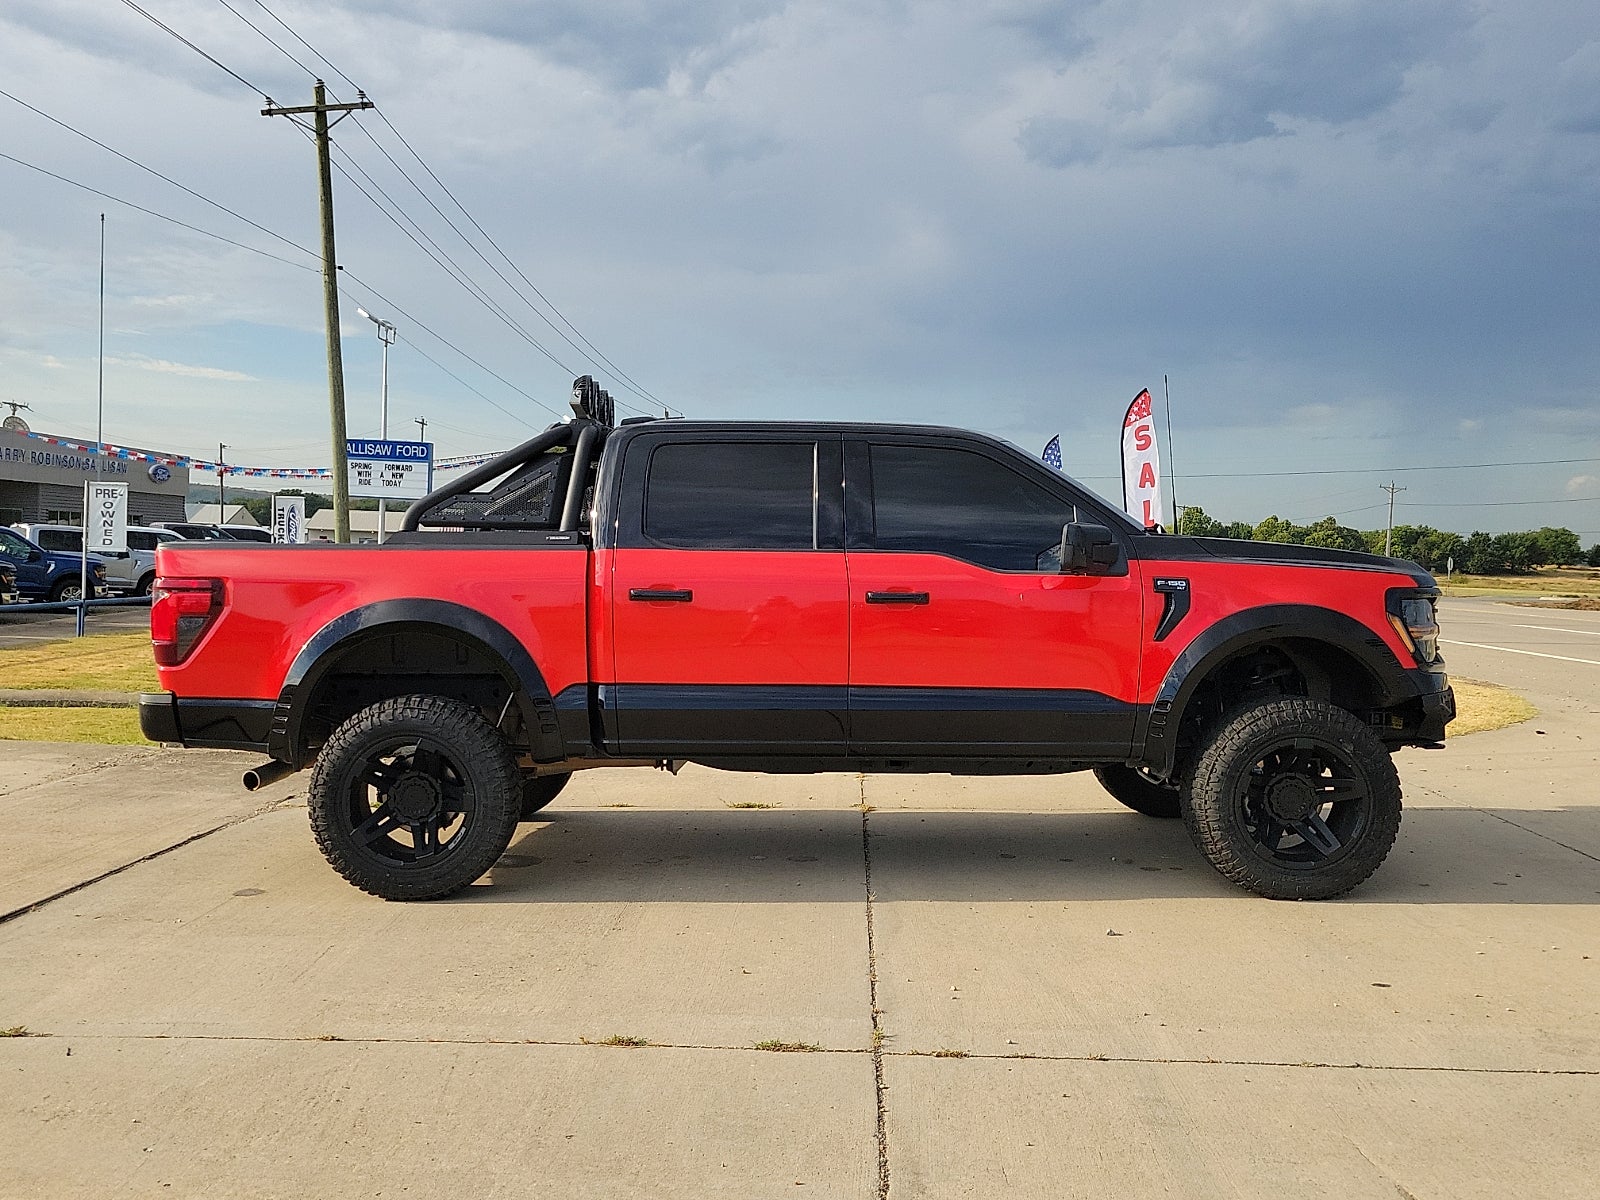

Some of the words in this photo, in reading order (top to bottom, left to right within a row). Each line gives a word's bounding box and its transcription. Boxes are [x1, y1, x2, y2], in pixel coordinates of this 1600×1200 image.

[396, 445, 428, 457] FORD
[31, 450, 81, 468] ROBINSON
[83, 457, 128, 473] SALISAW
[350, 462, 372, 470] SPRING
[384, 463, 413, 472] FORWARD
[357, 470, 371, 478] WITH
[380, 471, 385, 479] A
[391, 472, 405, 480] NEW
[358, 478, 371, 486] RIDE
[381, 479, 402, 488] TODAY
[101, 501, 115, 546] OWNED
